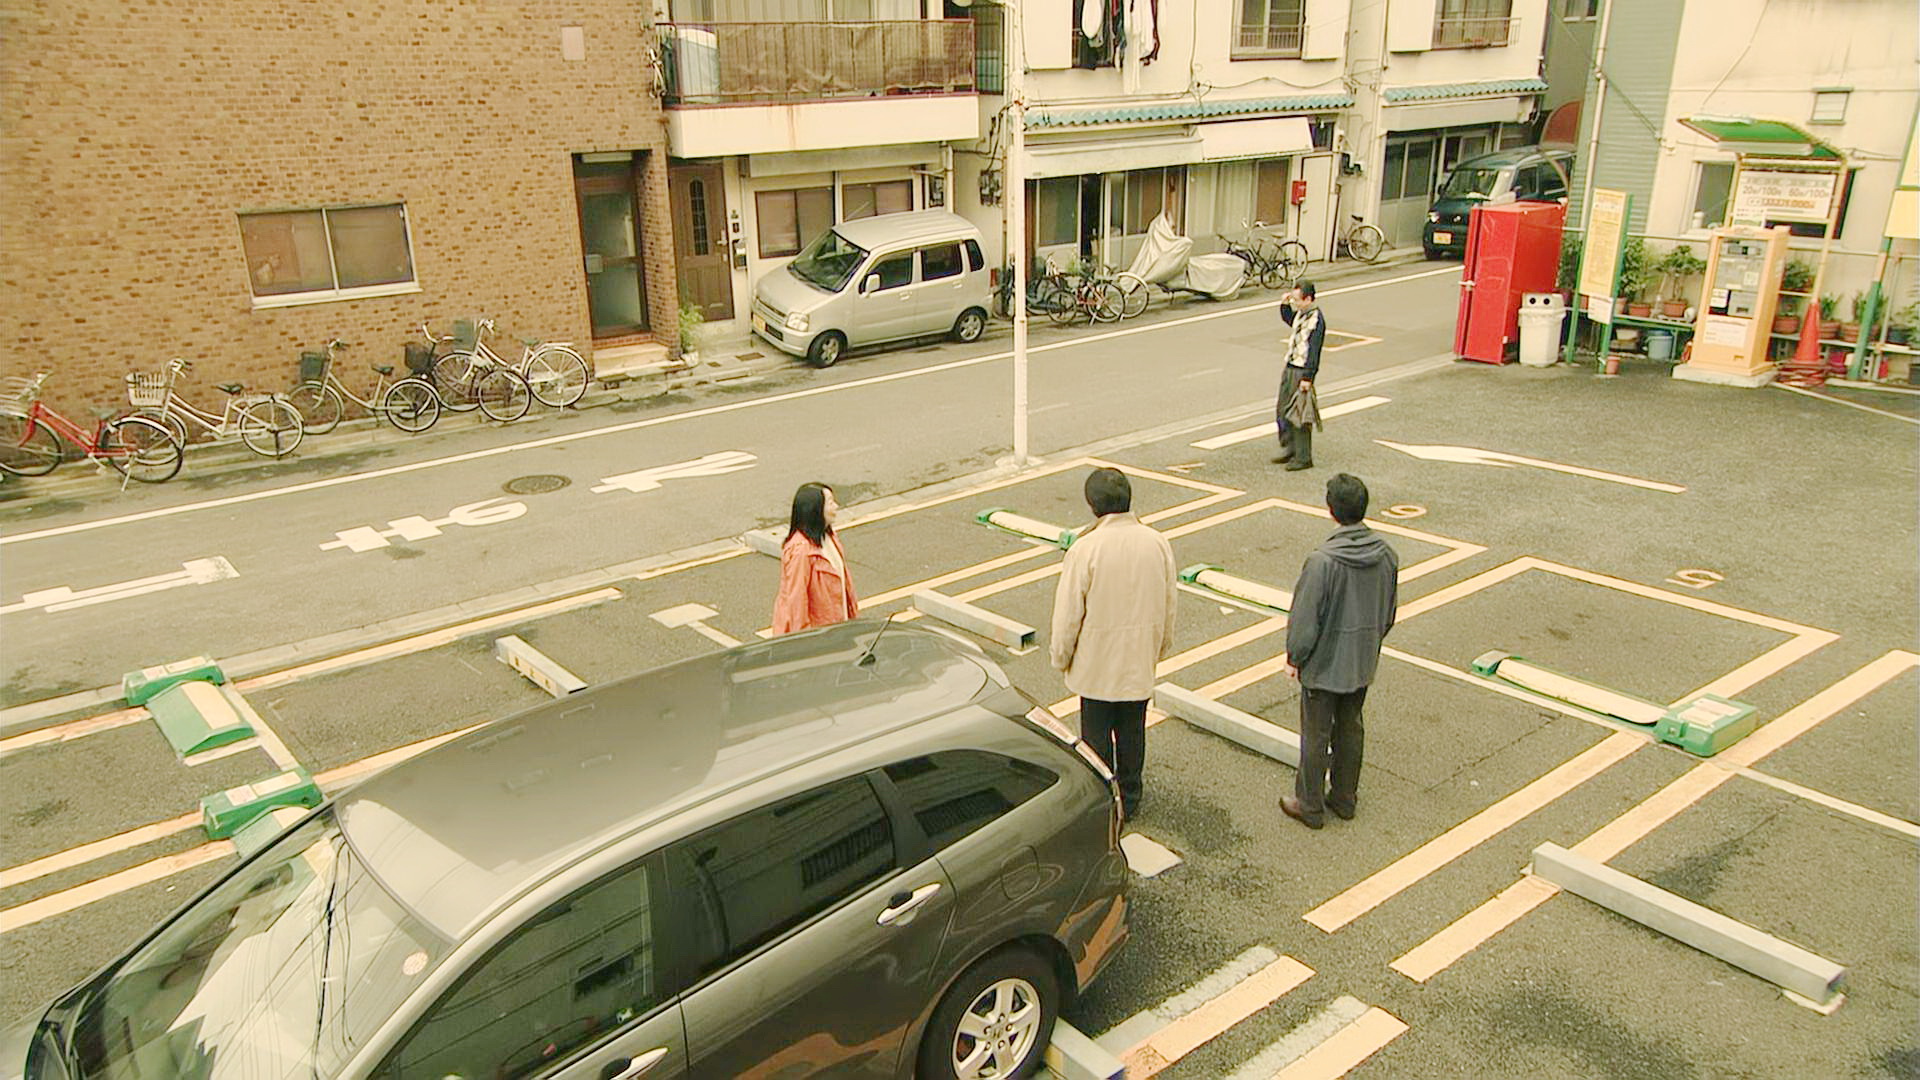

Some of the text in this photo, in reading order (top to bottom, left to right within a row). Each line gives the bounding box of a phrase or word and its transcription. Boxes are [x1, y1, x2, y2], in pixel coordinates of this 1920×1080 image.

[0, 450, 758, 614] 止まれ
[1665, 569, 1724, 589] 5
